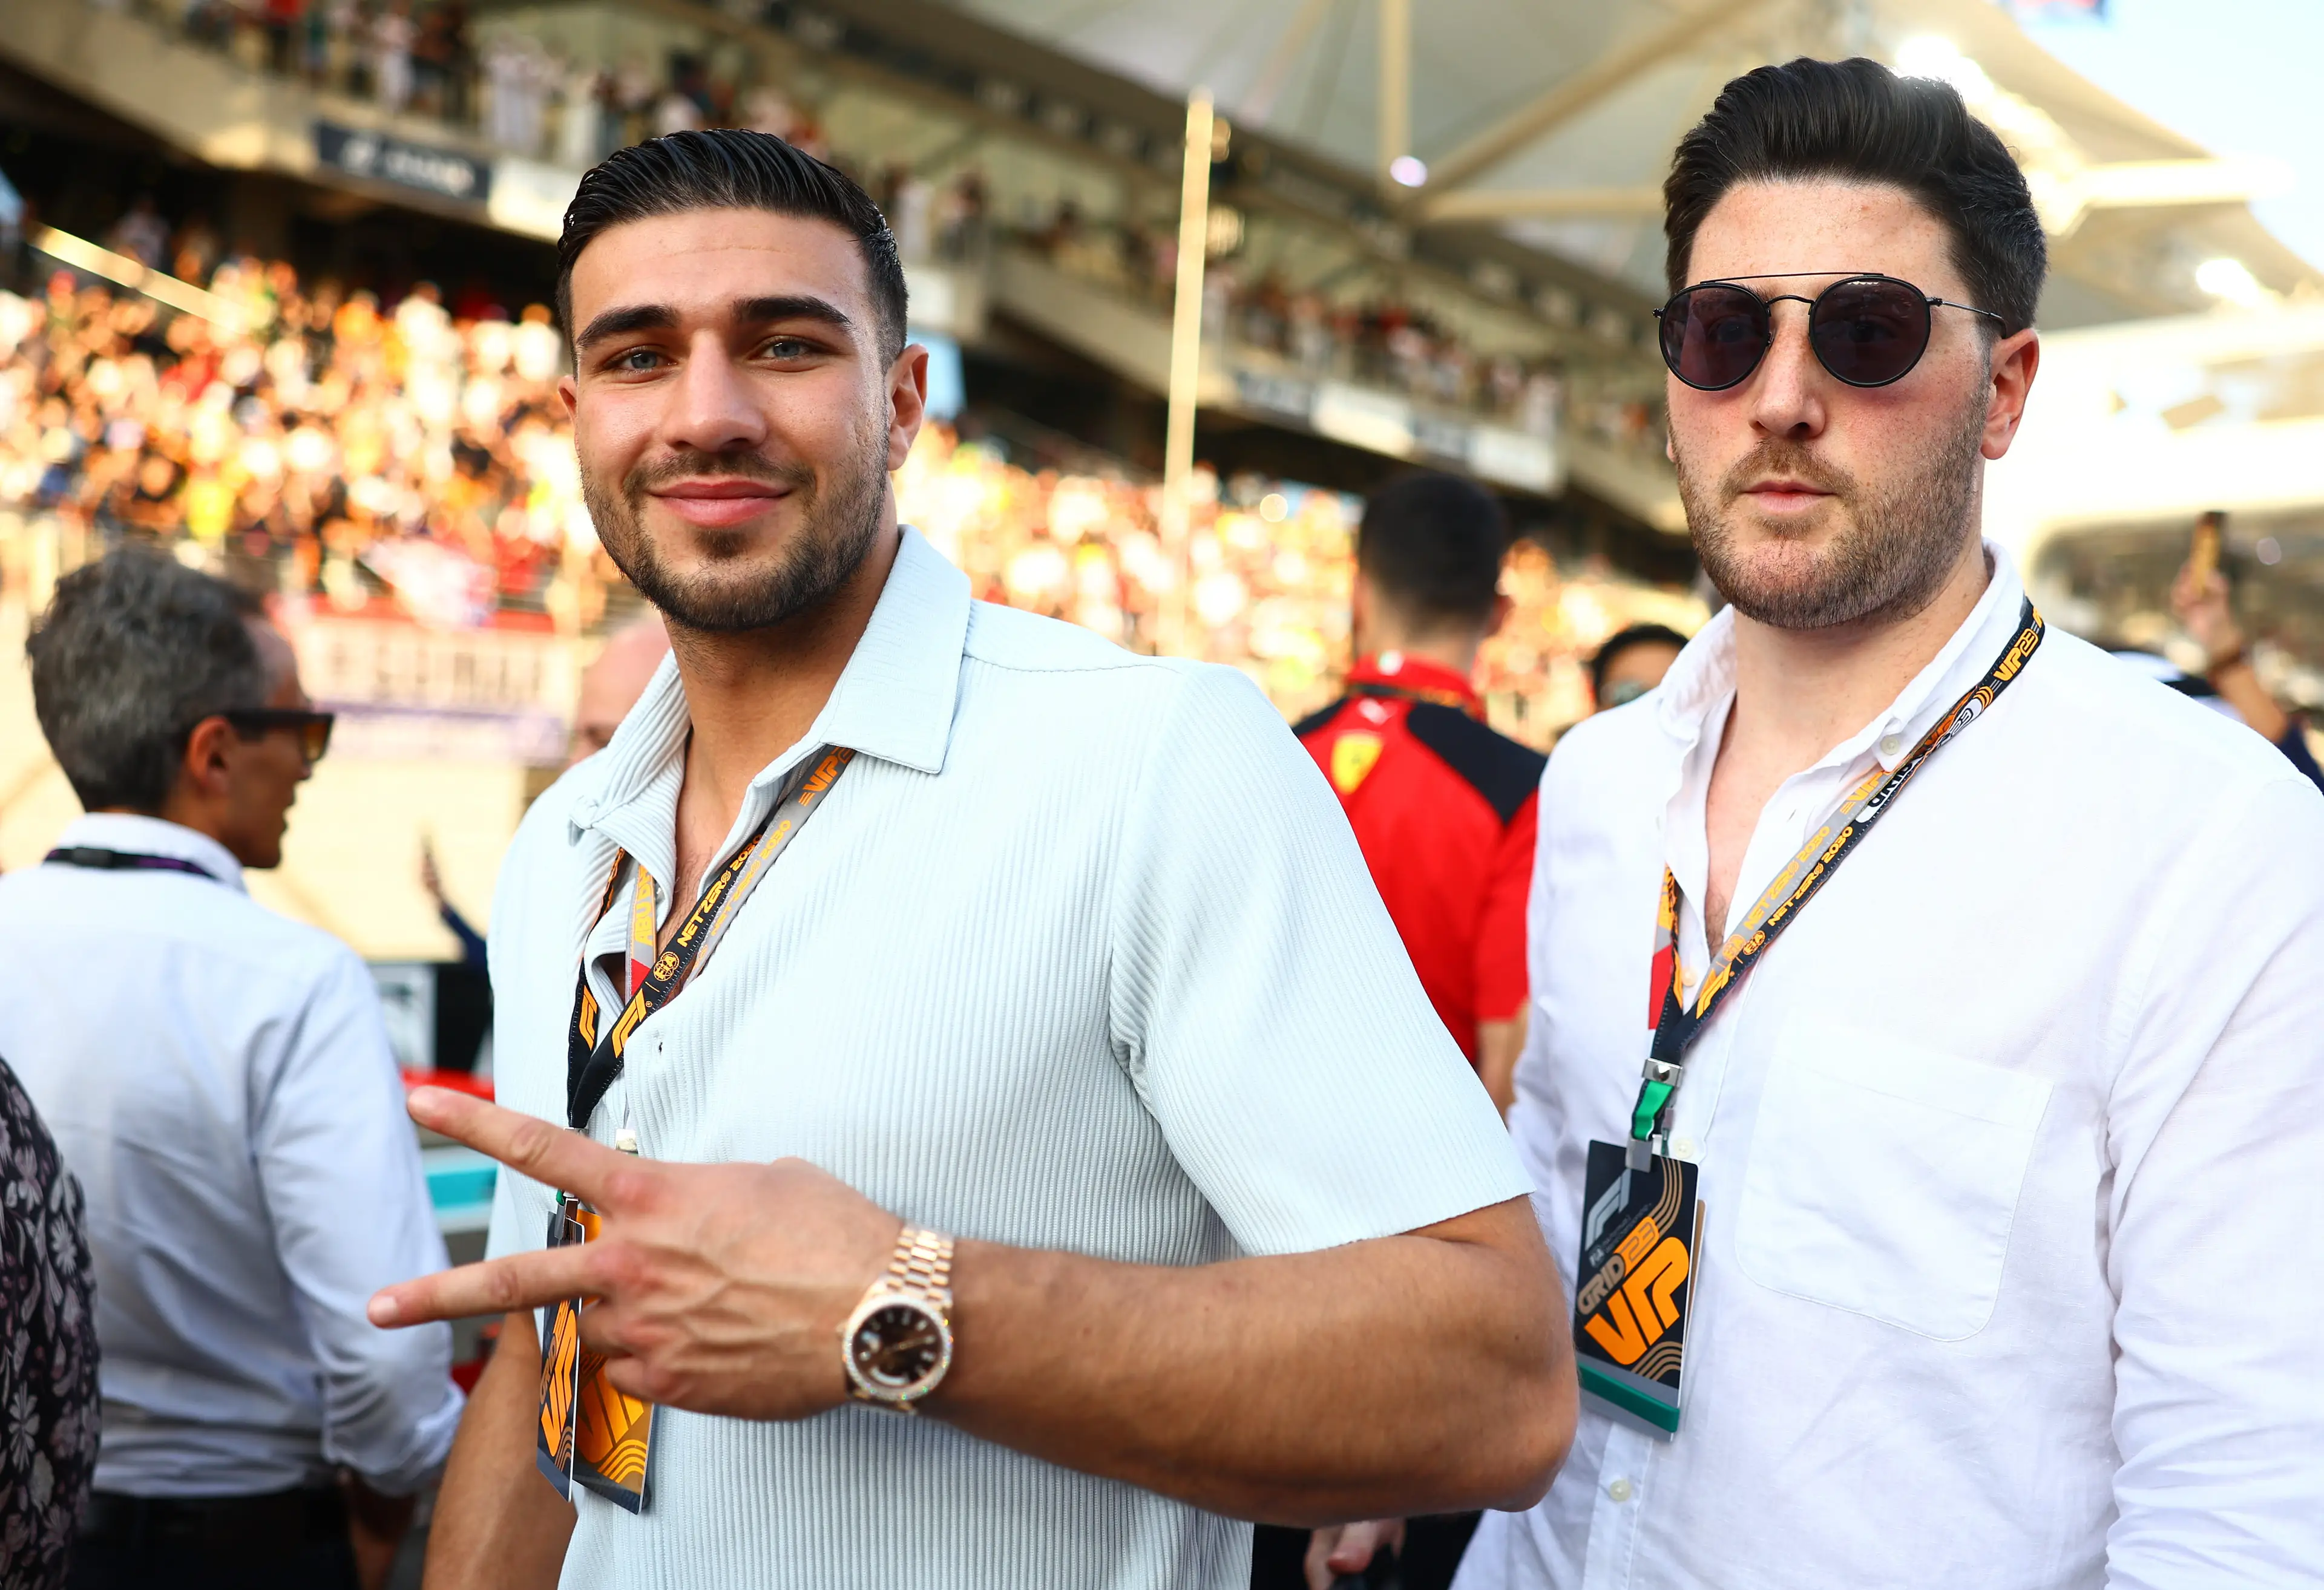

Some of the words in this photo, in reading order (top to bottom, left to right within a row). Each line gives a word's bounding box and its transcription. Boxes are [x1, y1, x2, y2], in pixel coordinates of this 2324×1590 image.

[729, 834, 763, 872] 2030
[759, 820, 792, 860] 2030
[1744, 898, 1770, 931] NET
[1796, 826, 1830, 863] 2030
[1767, 898, 1794, 927] NET
[1820, 826, 1853, 863] 2030
[635, 901, 653, 946] ABU
[1584, 1237, 1690, 1365] VIP
[540, 1309, 576, 1456] VIP
